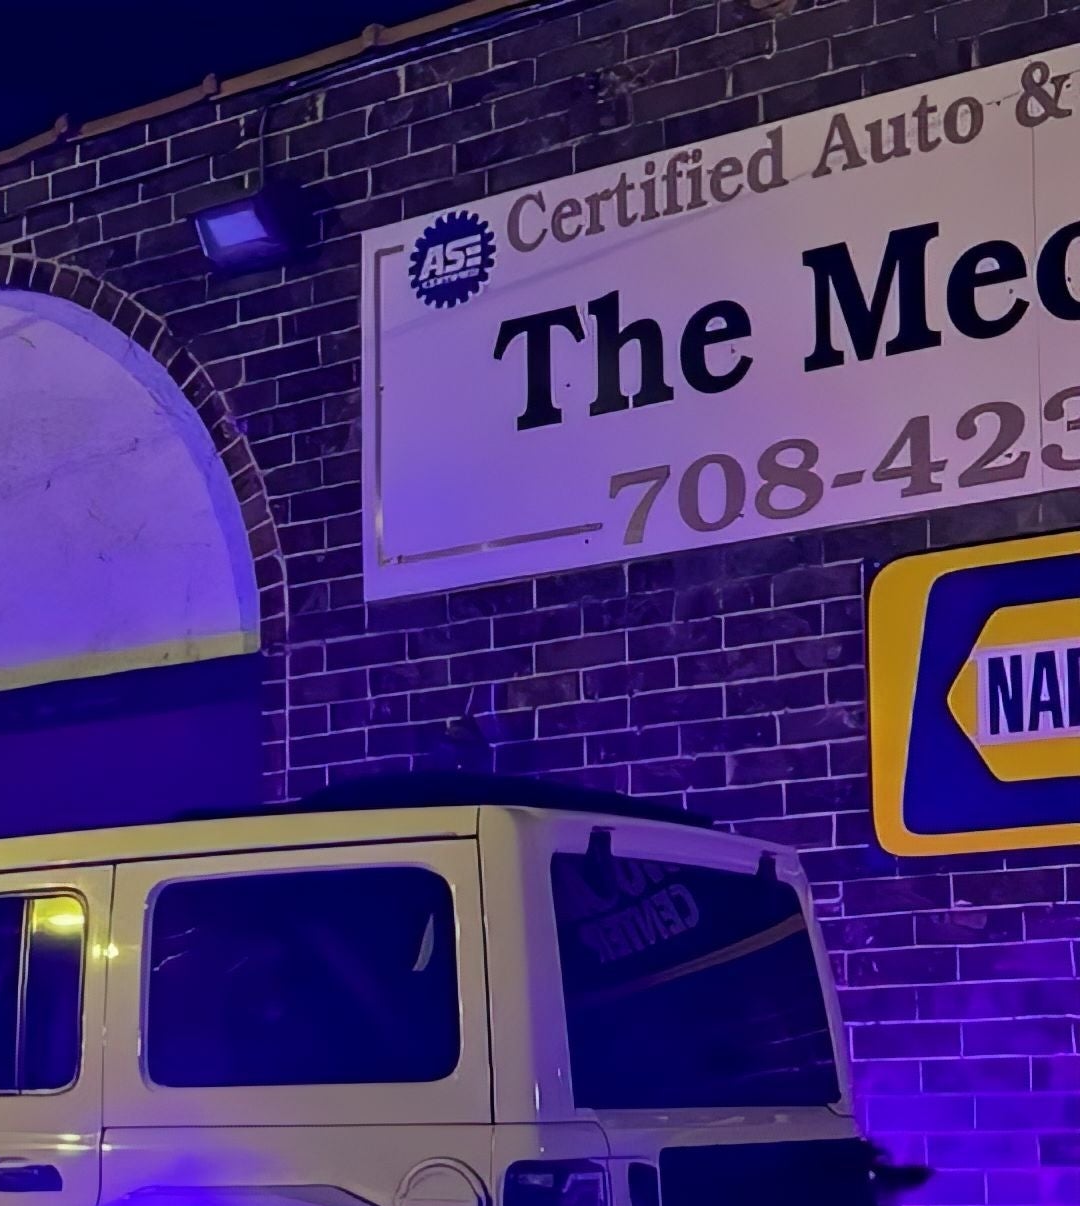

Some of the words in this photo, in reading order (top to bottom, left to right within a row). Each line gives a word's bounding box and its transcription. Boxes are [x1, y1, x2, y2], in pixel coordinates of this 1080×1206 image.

[506, 127, 787, 254] Certified
[810, 95, 984, 177] Auto
[1014, 60, 1071, 128] &
[419, 233, 481, 279] ASE
[493, 291, 754, 431] The
